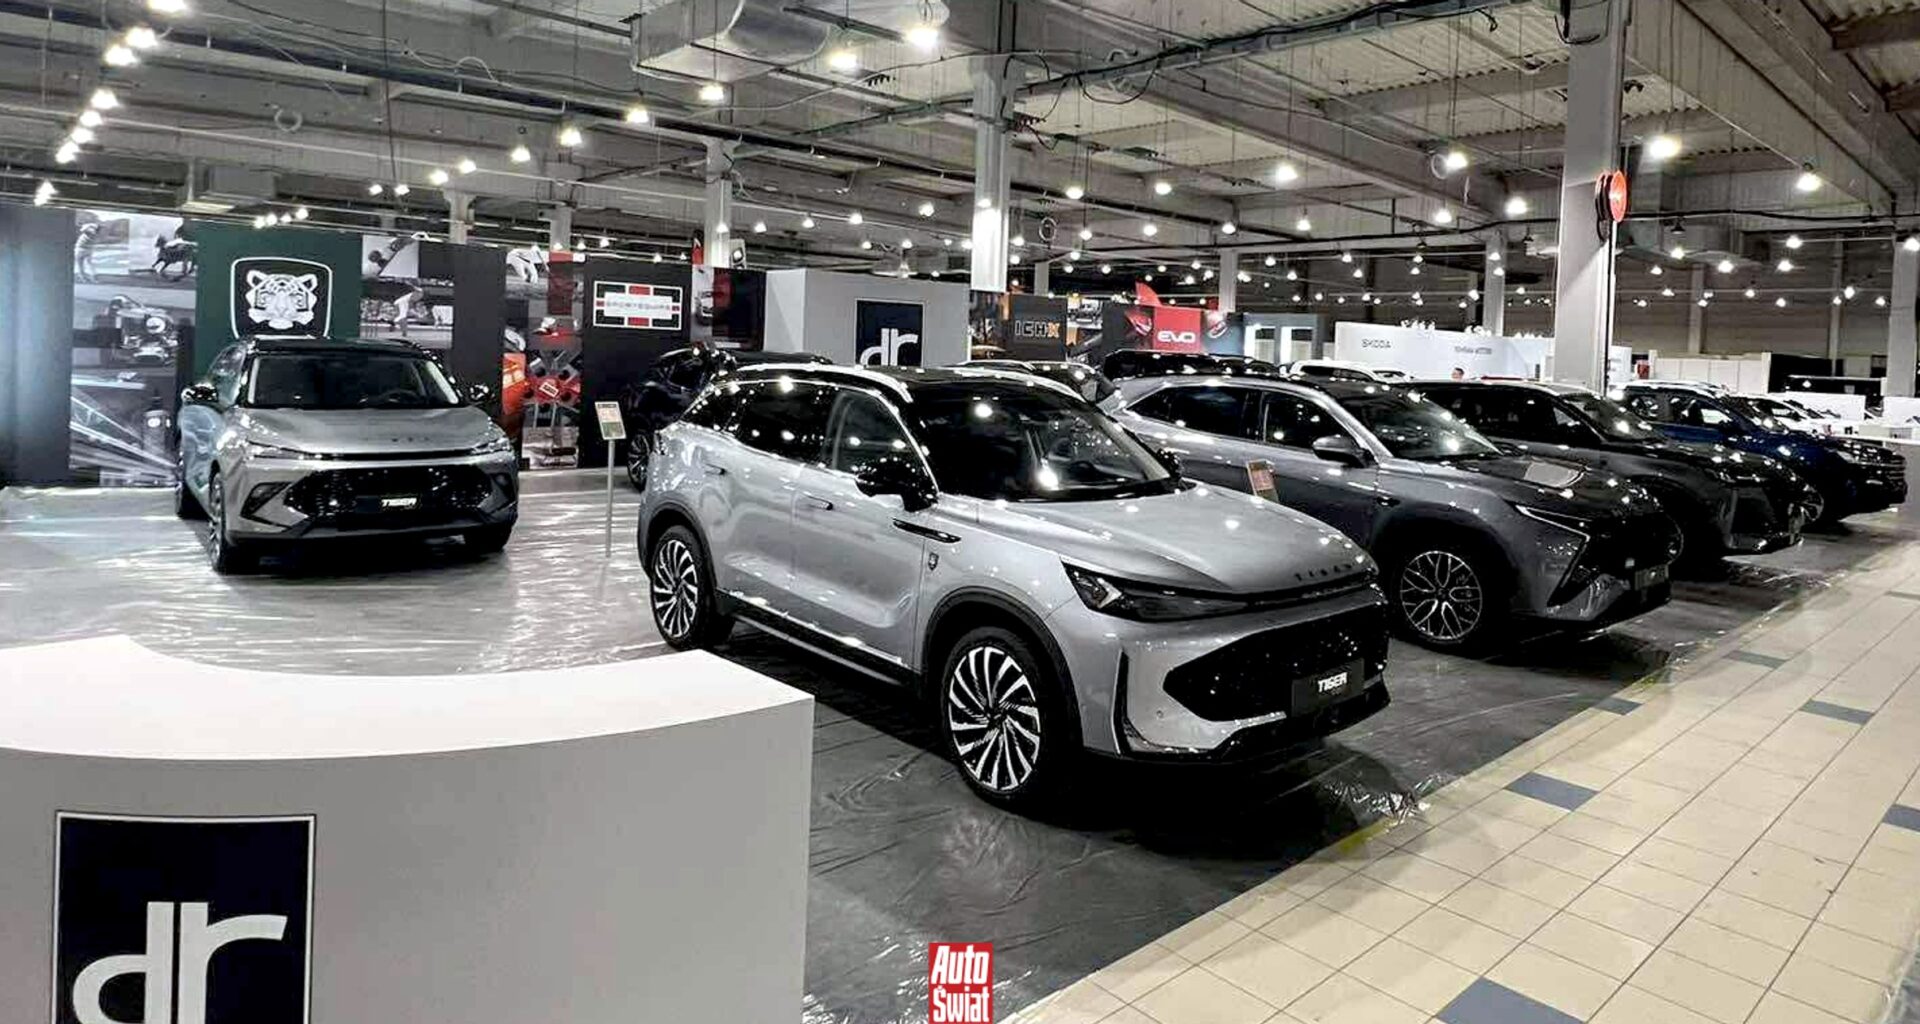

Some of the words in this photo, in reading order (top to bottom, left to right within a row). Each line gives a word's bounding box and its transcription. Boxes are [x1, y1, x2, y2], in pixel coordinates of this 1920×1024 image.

[1015, 320, 1060, 338] ICHX
[1157, 331, 1196, 343] EVO
[861, 328, 919, 366] dr
[382, 498, 417, 507] TIGER
[1318, 672, 1347, 693] TIGER
[73, 901, 288, 1024] dr
